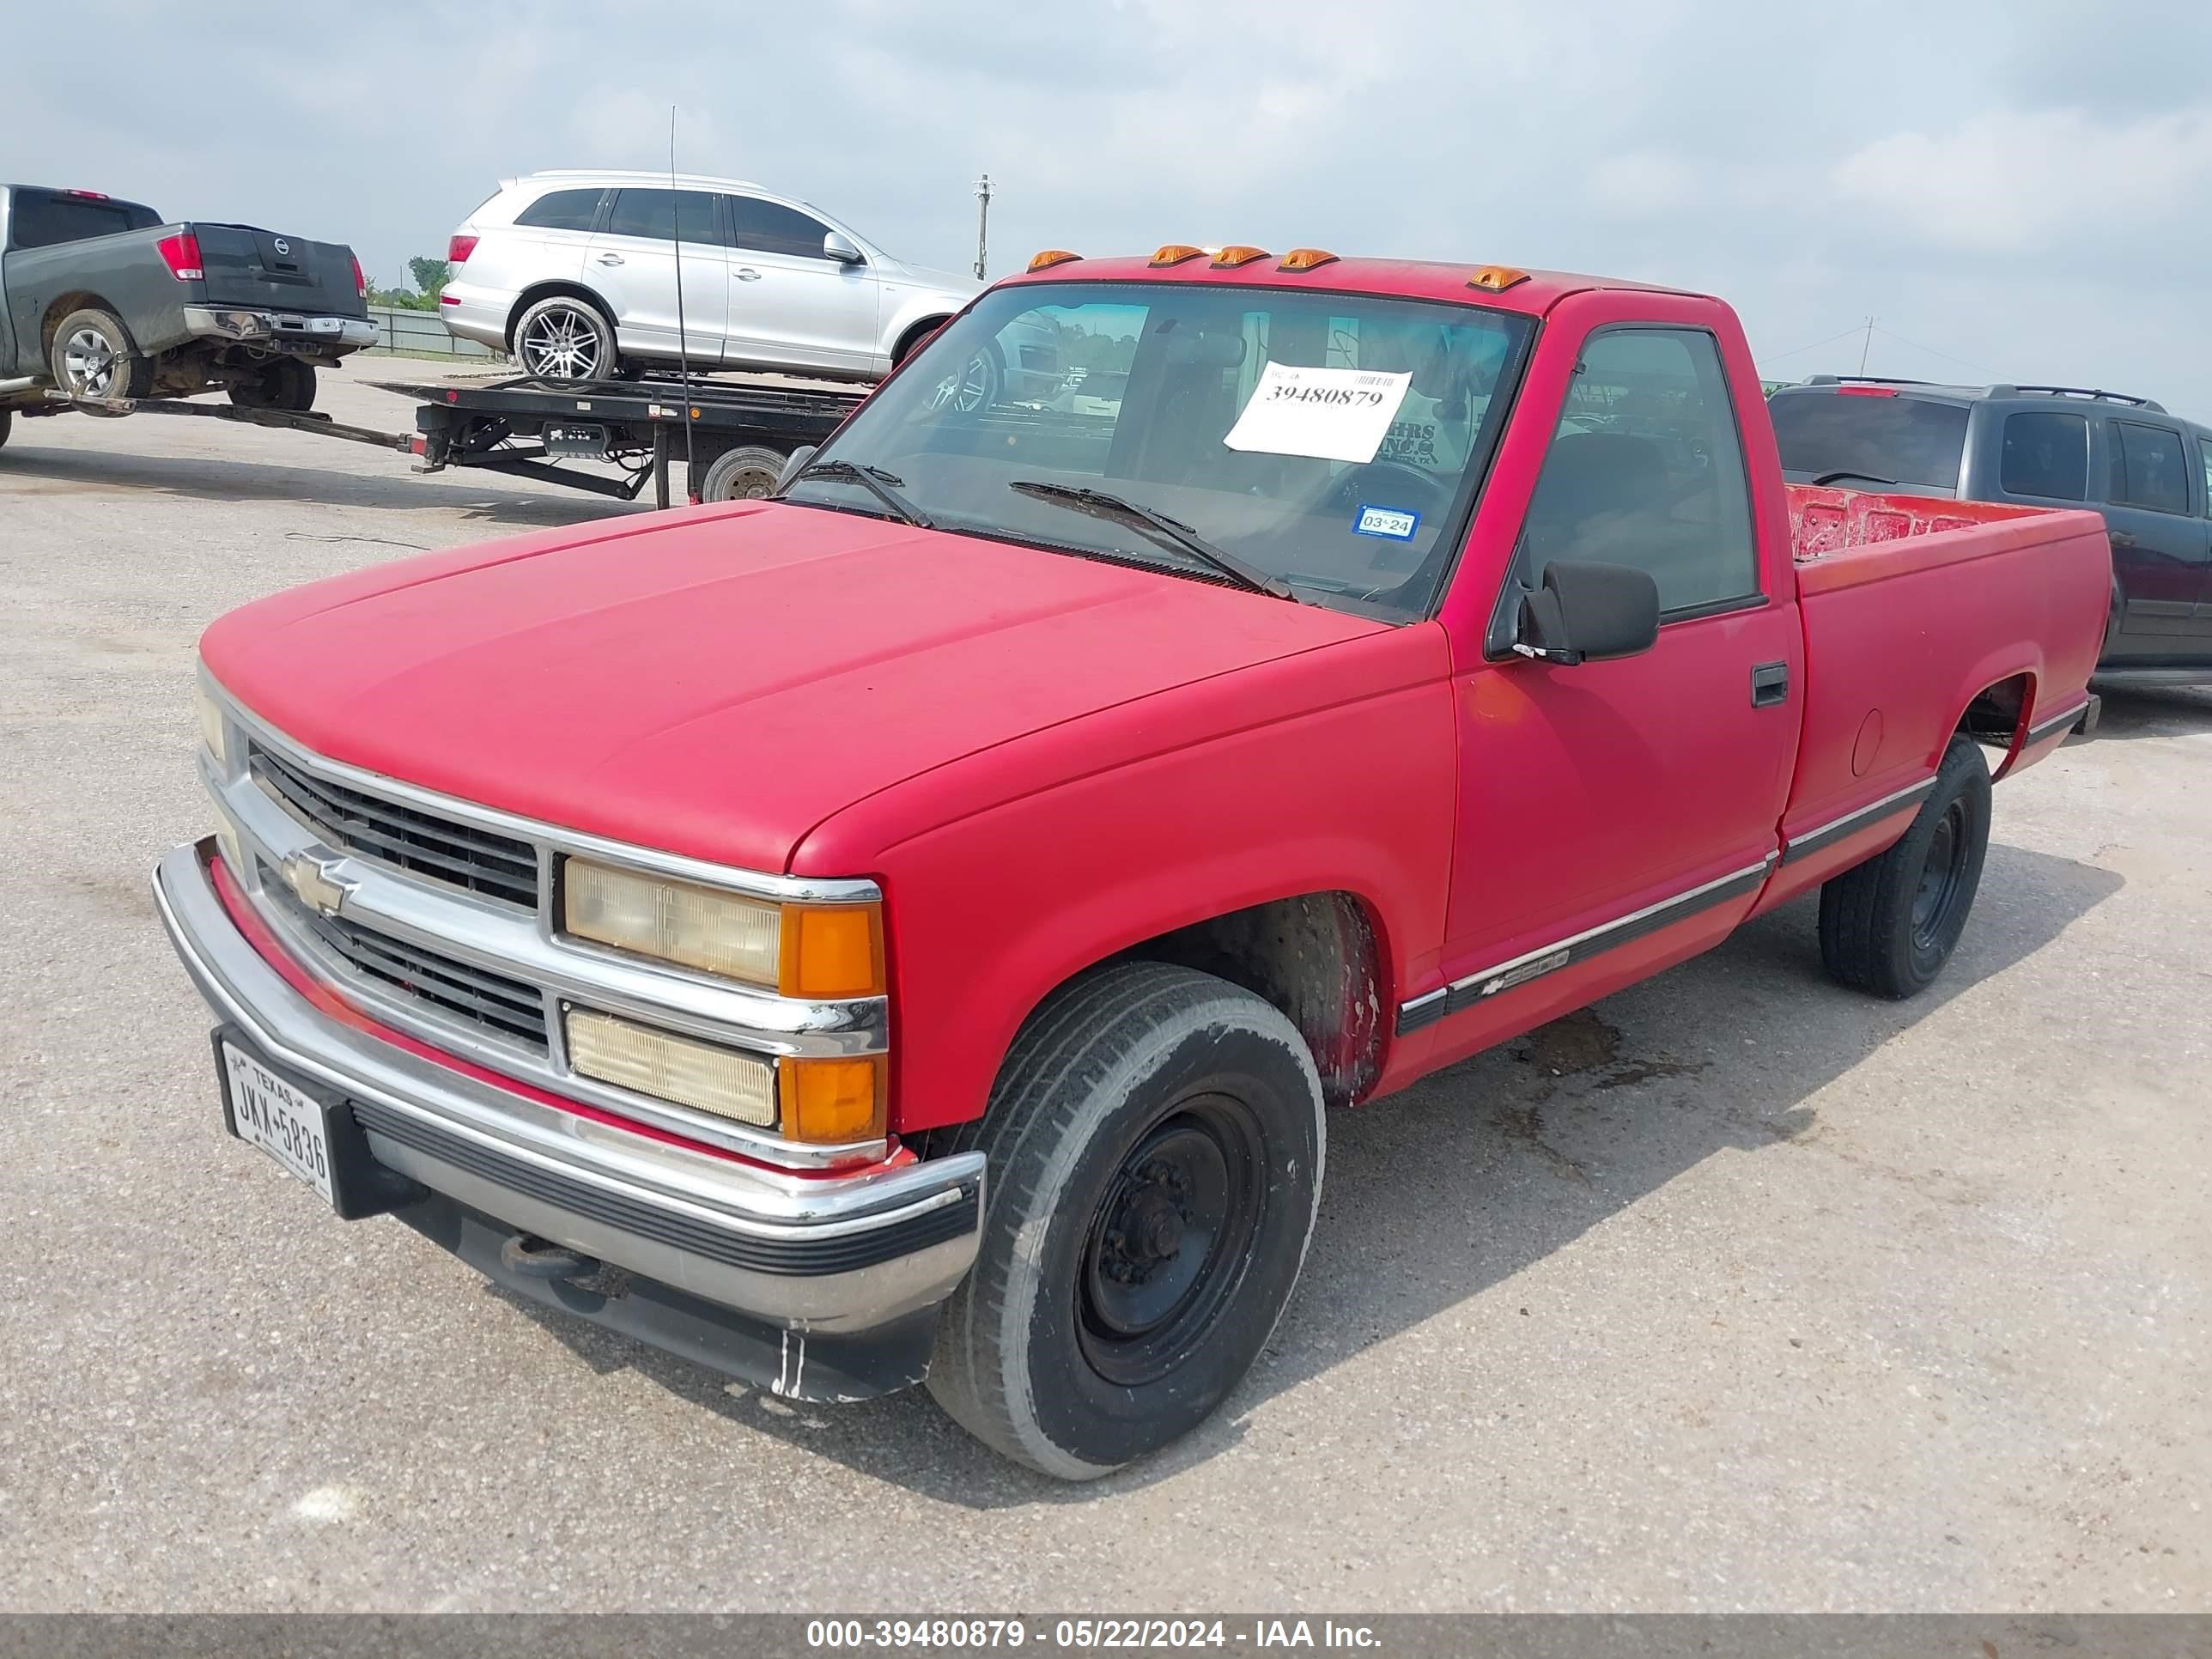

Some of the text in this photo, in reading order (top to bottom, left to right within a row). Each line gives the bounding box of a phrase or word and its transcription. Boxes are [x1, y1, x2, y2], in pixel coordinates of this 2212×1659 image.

[1266, 386, 1383, 408] 39480879
[1364, 515, 1382, 528] 03
[1389, 520, 1409, 532] 24
[252, 1066, 294, 1107] TEXAS
